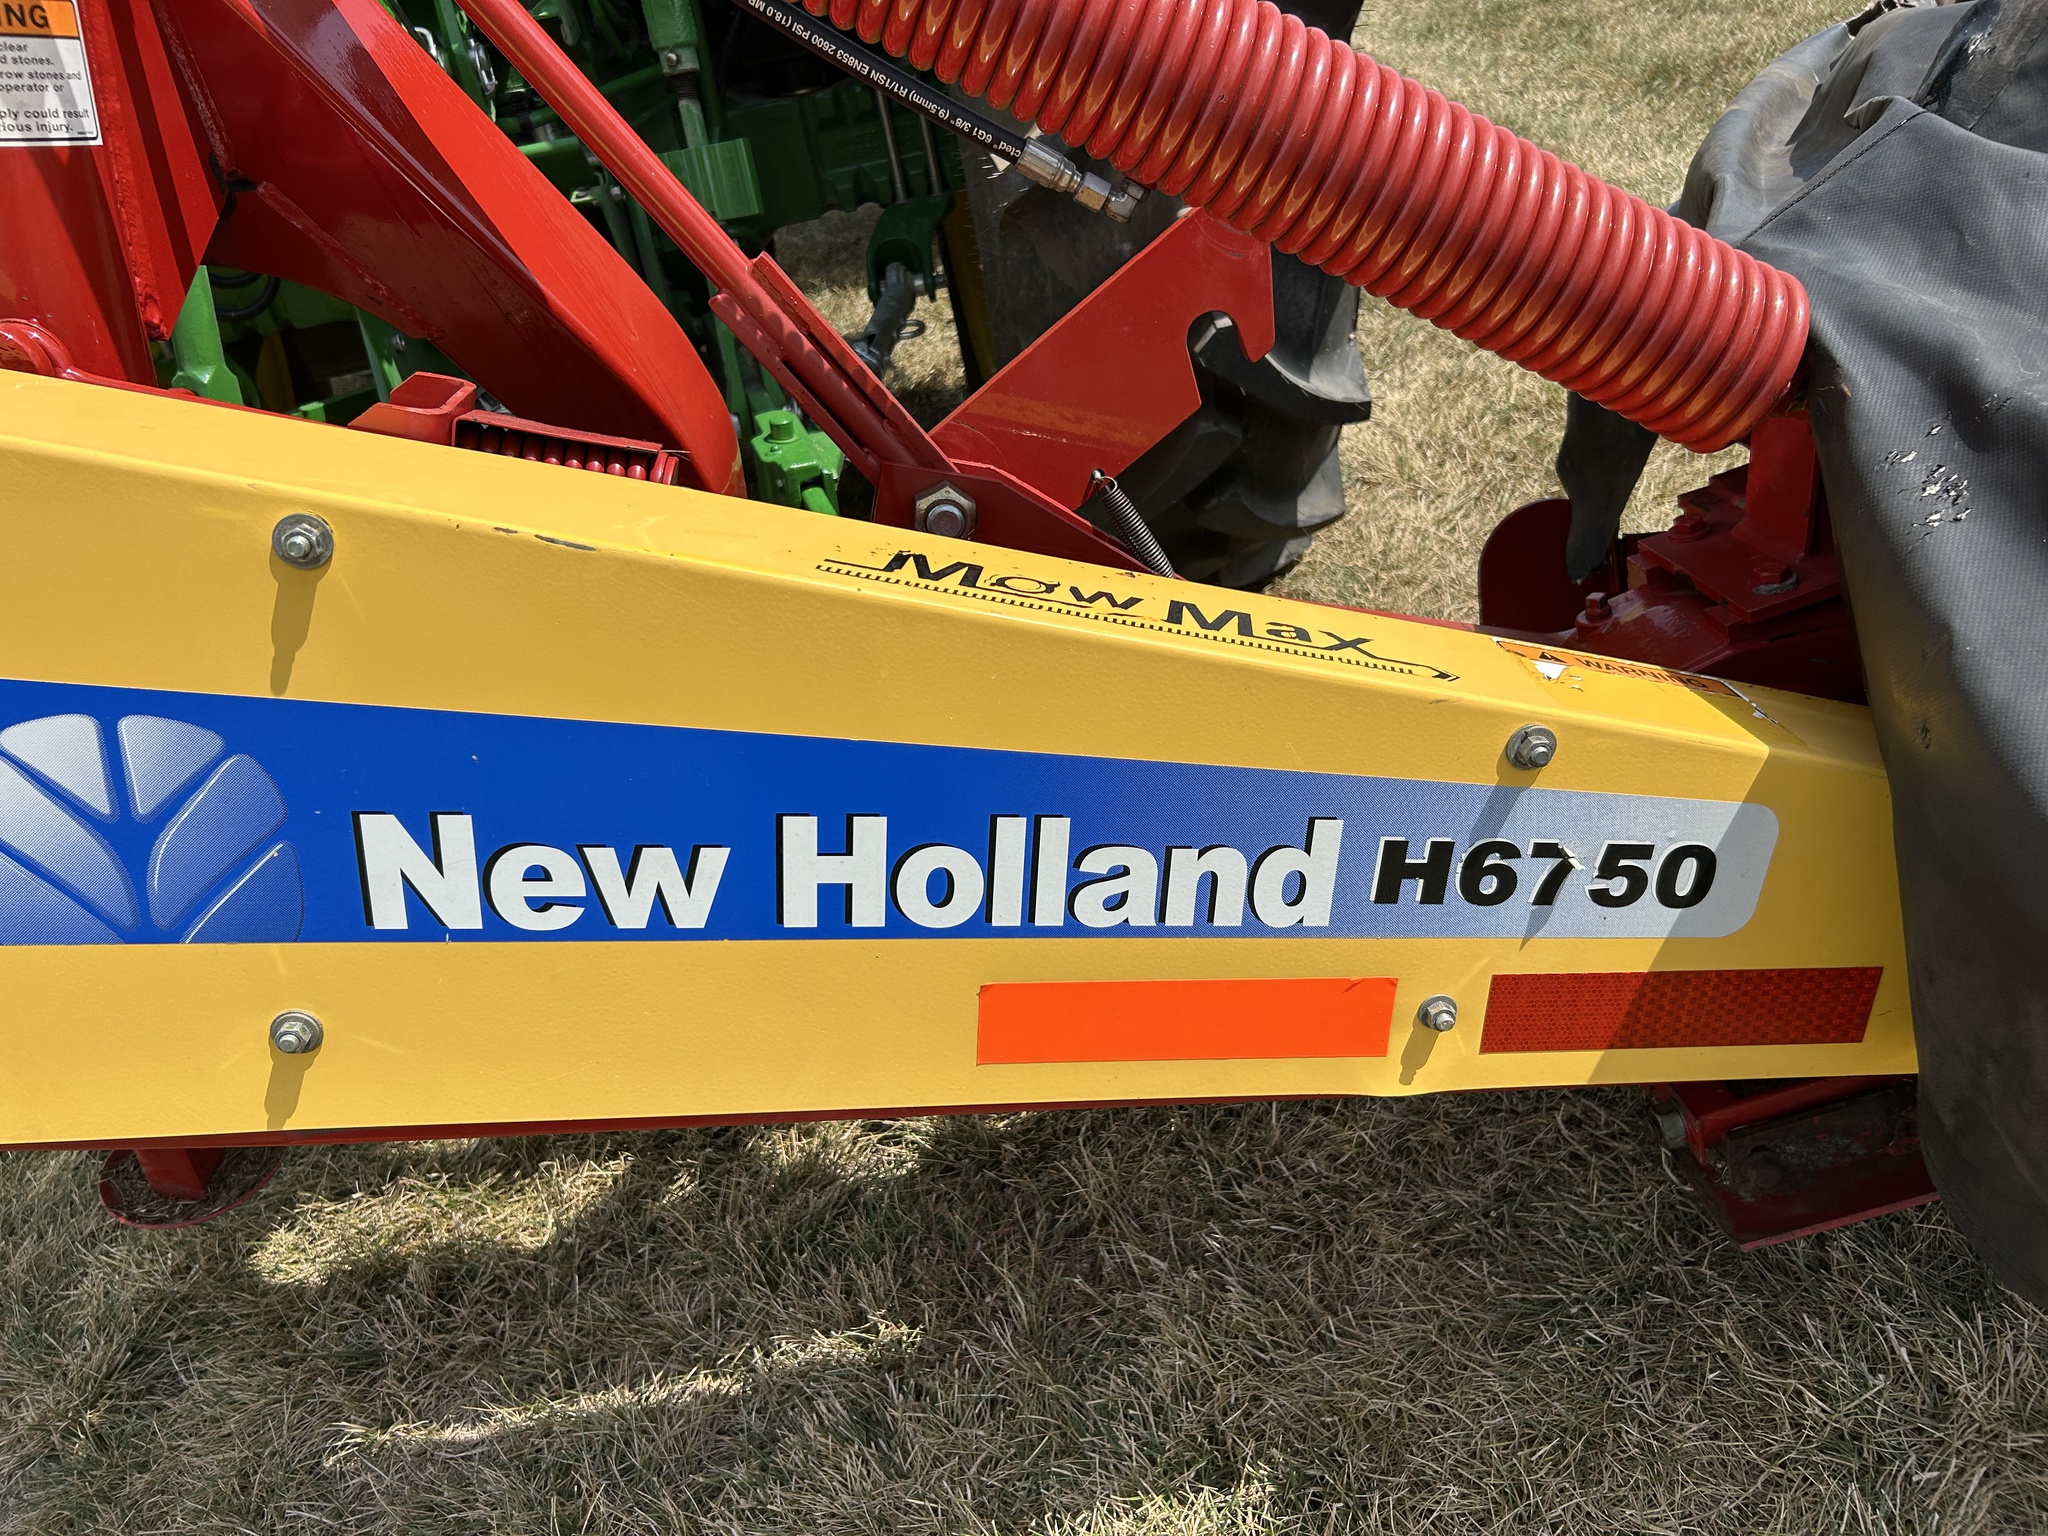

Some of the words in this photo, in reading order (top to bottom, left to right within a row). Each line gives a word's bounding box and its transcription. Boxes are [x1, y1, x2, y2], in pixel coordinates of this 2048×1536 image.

[0, 3, 49, 28] NG
[766, 6, 792, 28] (18.0
[791, 22, 811, 40] PSI
[811, 34, 837, 55] 2600
[11, 55, 55, 66] stones.
[836, 49, 870, 76] EN853
[27, 70, 65, 80] stones
[66, 71, 81, 80] and
[869, 69, 908, 98] R1/1SN
[53, 84, 64, 92] or
[24, 108, 59, 119] could
[63, 108, 90, 118] result
[908, 89, 950, 121] (9.5mm)
[36, 121, 73, 134] injury.
[972, 126, 993, 144] 6G1
[883, 549, 1144, 610] Mow
[1161, 599, 1376, 659] Max
[352, 811, 731, 931] New
[774, 812, 1345, 931] Holland
[1369, 836, 1718, 909] H6750
